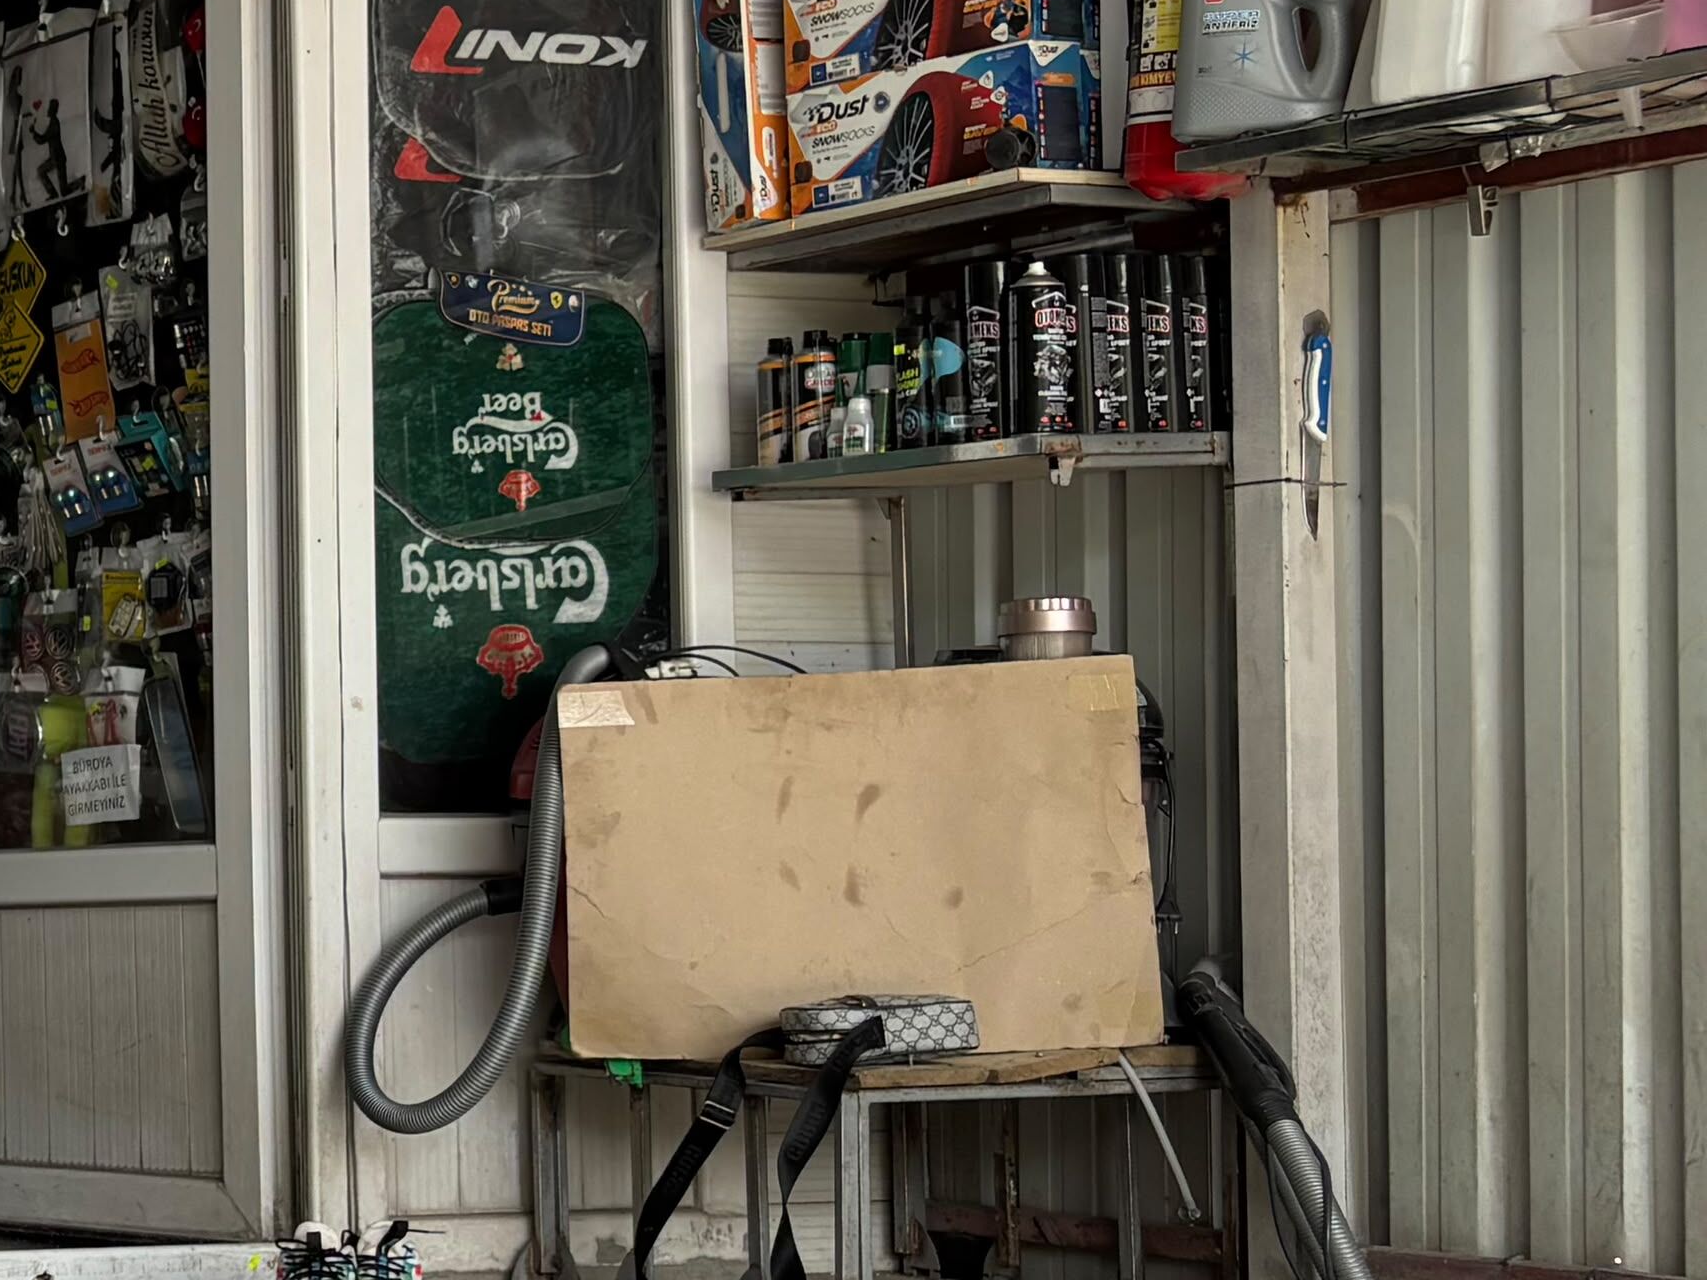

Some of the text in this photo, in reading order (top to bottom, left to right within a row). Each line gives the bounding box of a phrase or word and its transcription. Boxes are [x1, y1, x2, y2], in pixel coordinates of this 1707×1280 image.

[458, 27, 648, 69] KONI
[487, 279, 541, 315] Premium
[467, 307, 489, 325] OTO
[490, 310, 528, 334] PASPAS
[481, 391, 544, 420] Beer
[450, 419, 579, 472] Carlsberg
[400, 537, 610, 624] Carlsberg
[72, 756, 113, 774] BÜROYA
[68, 794, 126, 817] GİRMEYİNİZ
